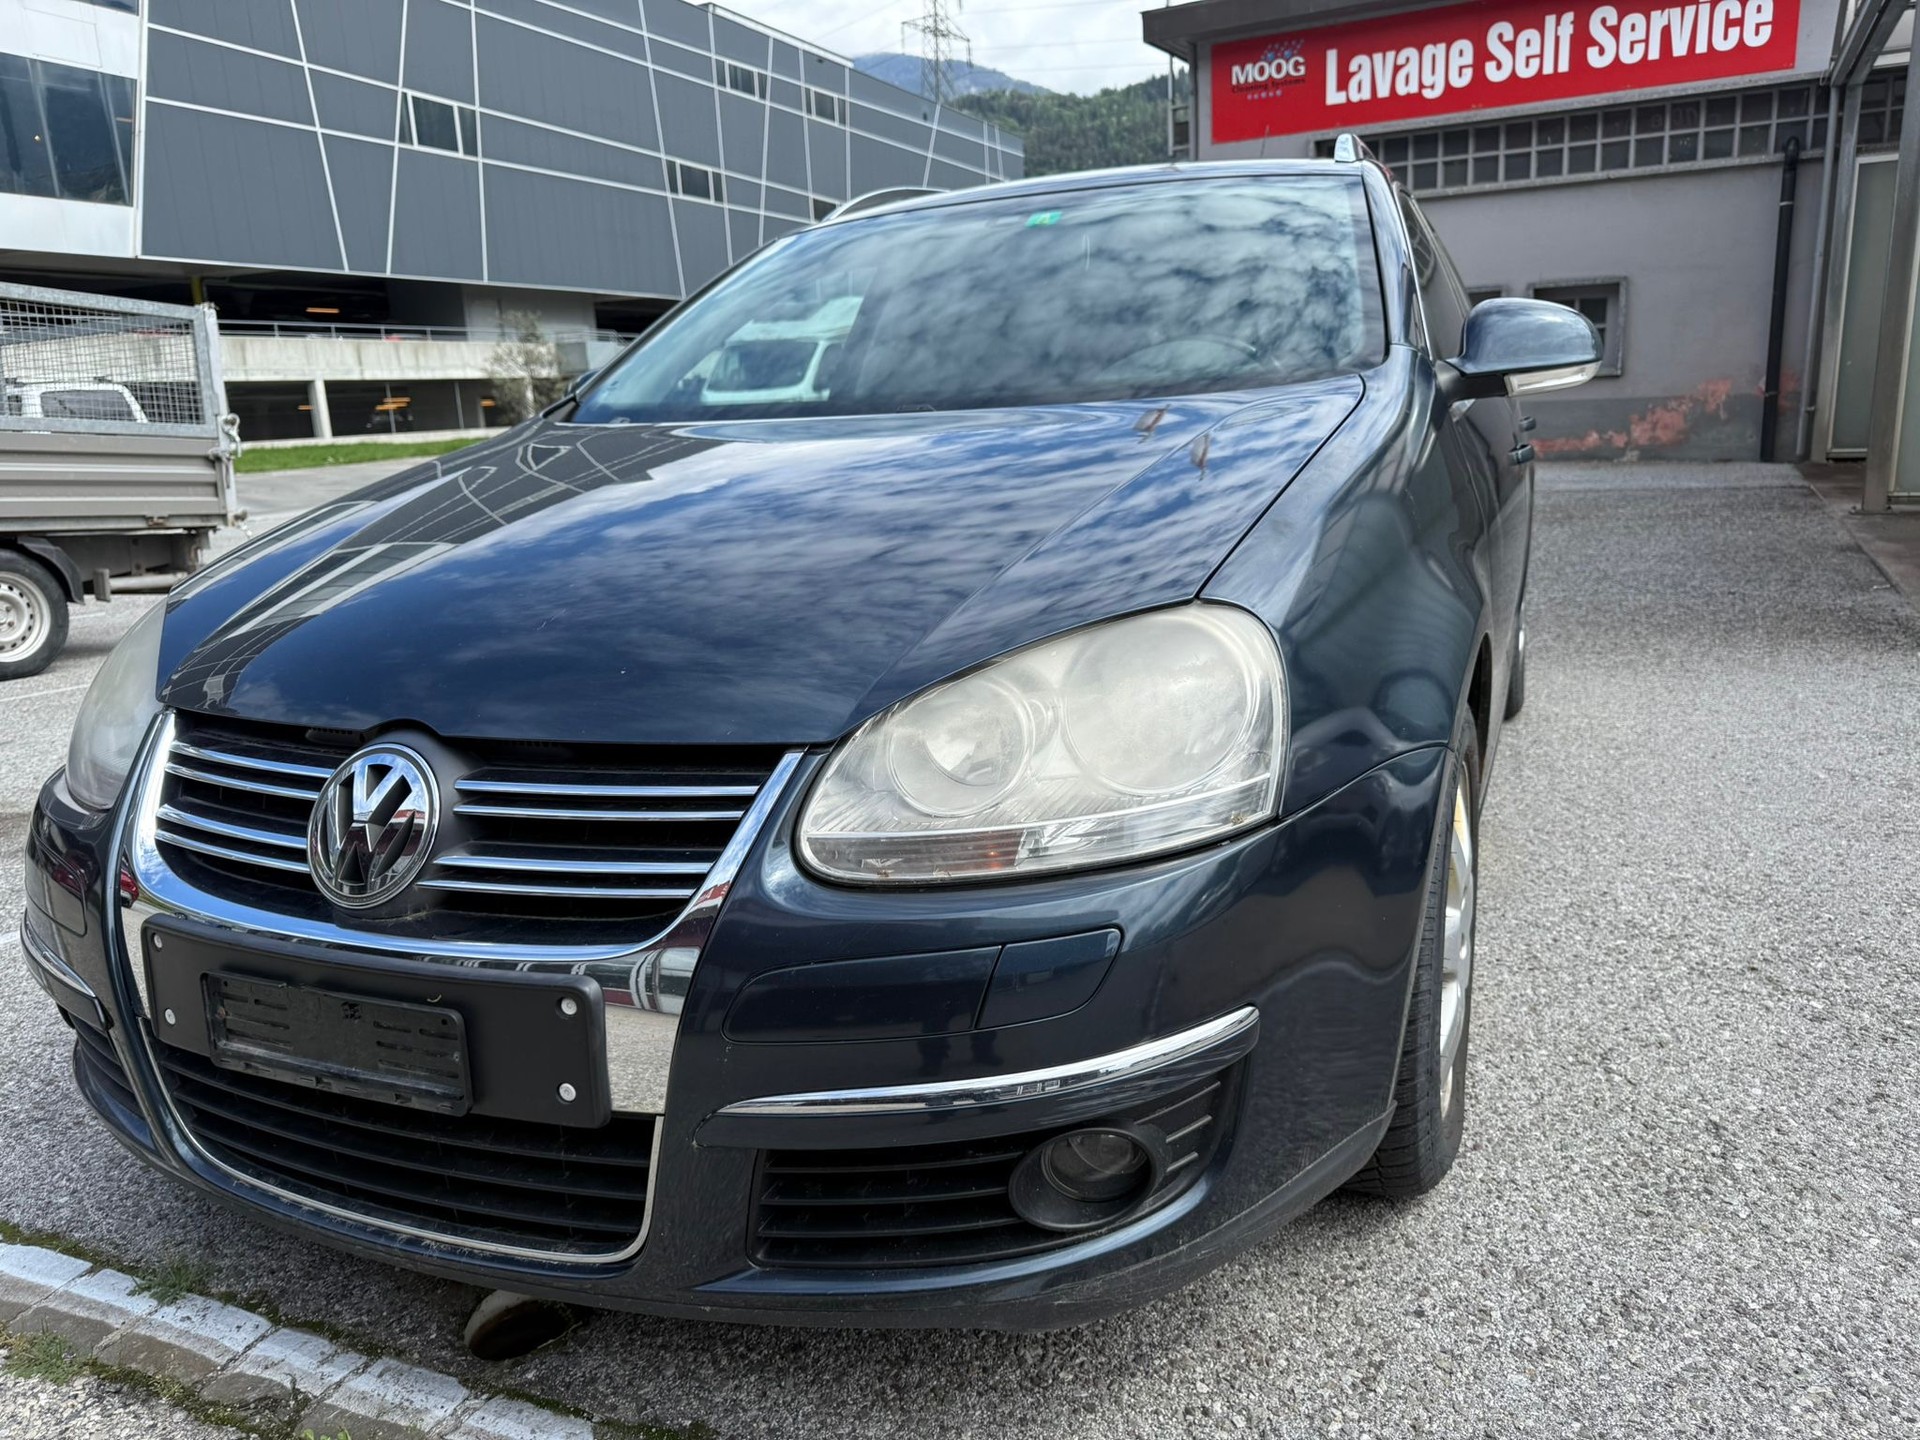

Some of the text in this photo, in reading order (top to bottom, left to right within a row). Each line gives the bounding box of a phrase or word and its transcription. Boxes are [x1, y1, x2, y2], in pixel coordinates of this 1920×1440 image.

[1232, 57, 1305, 84] MOOG
[1326, 0, 1773, 105] Lavage Self Service
[314, 750, 433, 901] VW
